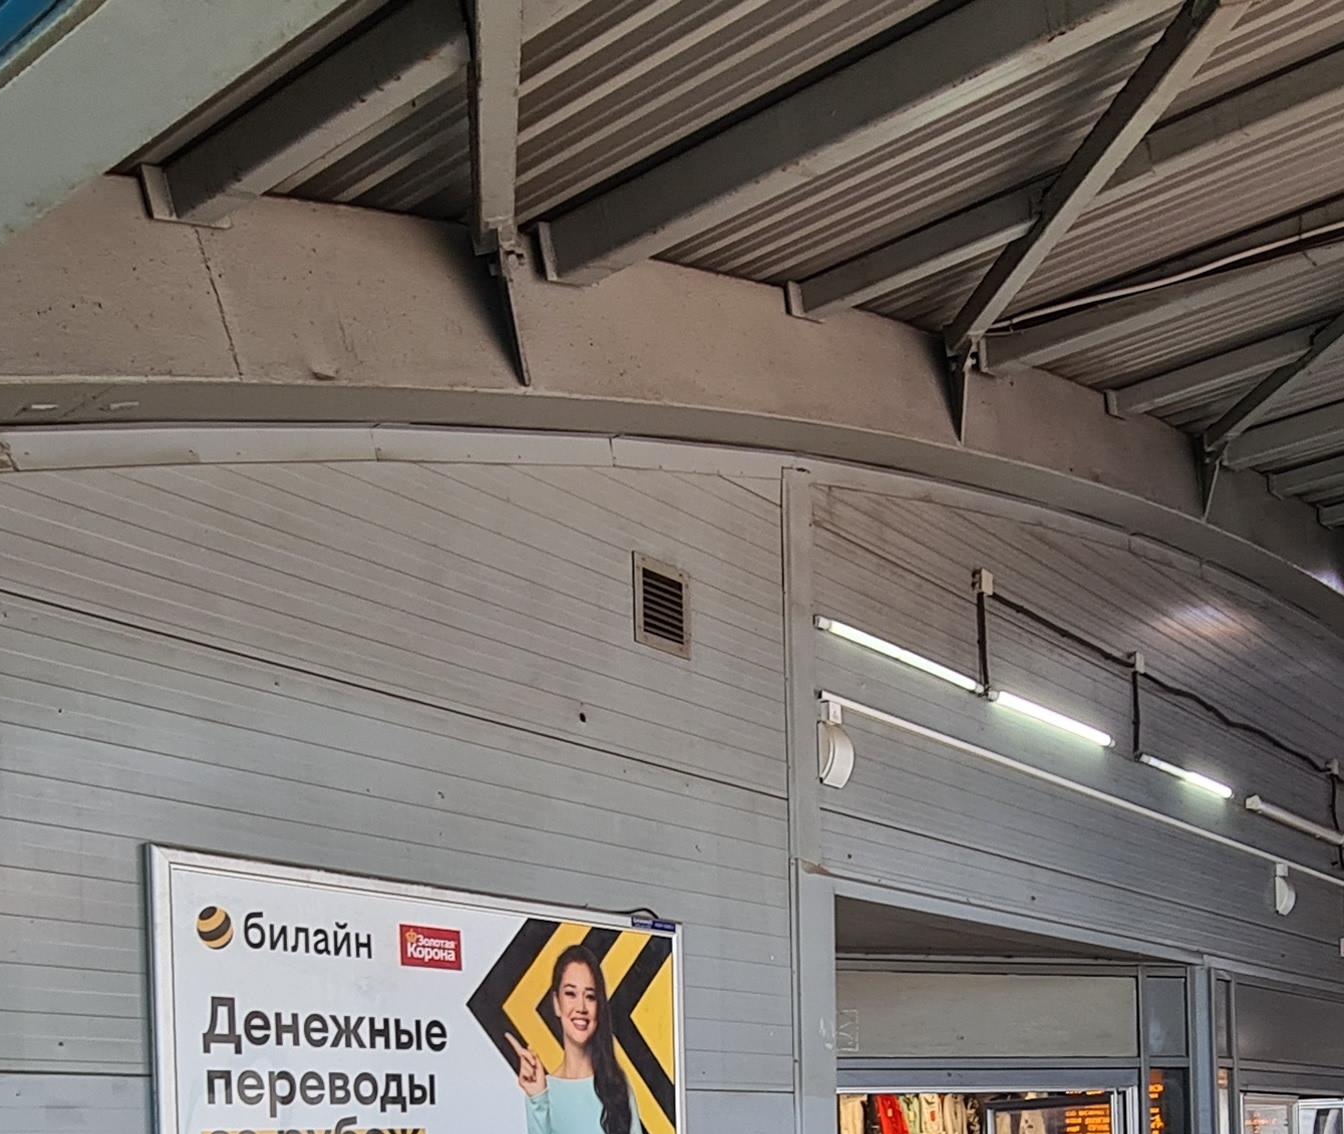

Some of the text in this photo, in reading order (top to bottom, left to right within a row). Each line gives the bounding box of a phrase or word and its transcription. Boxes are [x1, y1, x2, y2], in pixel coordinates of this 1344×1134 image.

[243, 912, 373, 960] билайн
[407, 941, 456, 962] Корона
[202, 996, 448, 1054] Денежные
[205, 1068, 436, 1117] переводы
